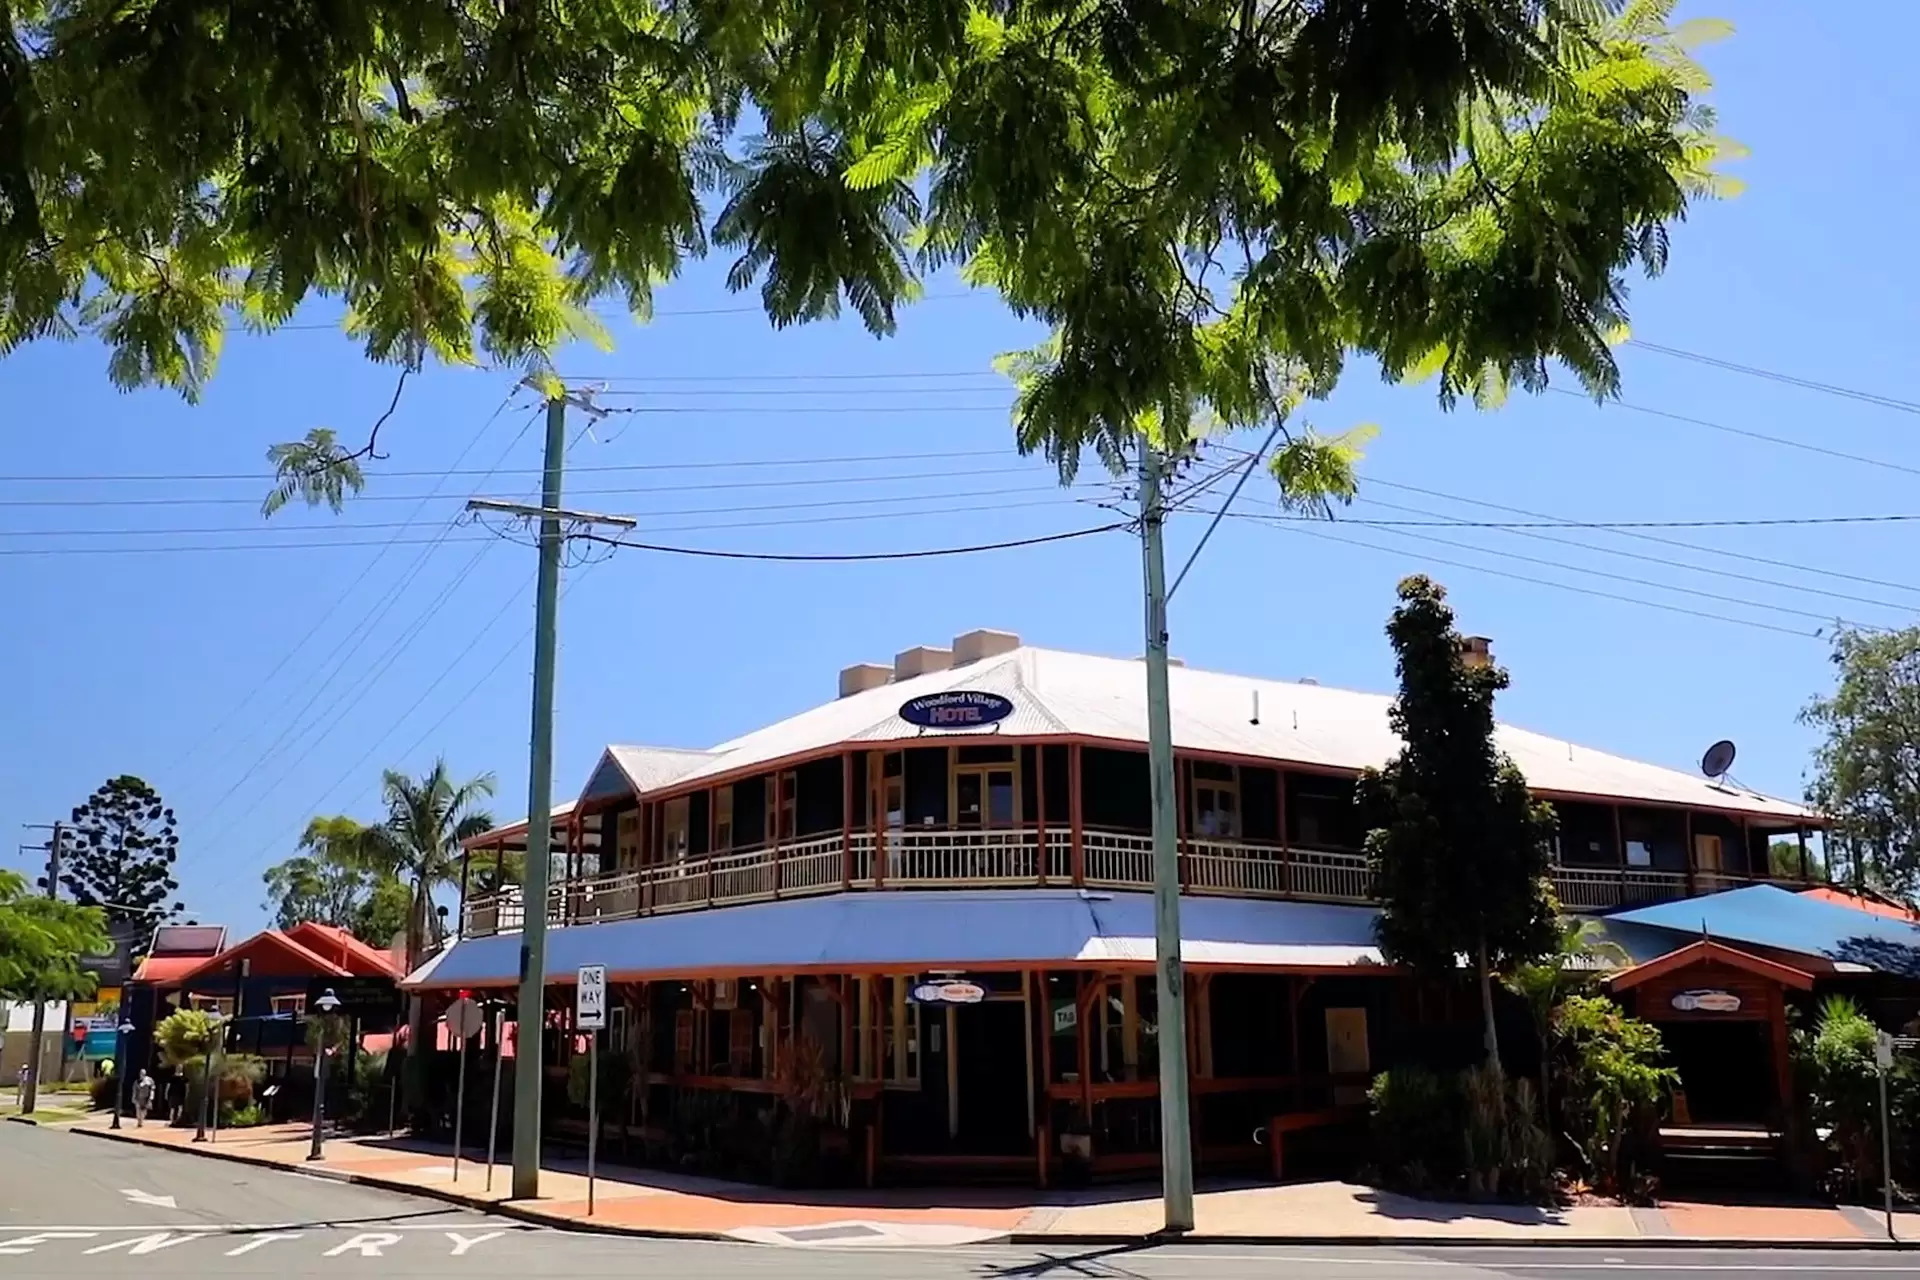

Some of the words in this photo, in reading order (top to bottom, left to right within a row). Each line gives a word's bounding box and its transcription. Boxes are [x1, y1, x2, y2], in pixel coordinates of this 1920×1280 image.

[912, 693, 966, 711] Woodford
[966, 693, 1002, 709] Village
[930, 707, 983, 723] HOTEL
[582, 971, 601, 985] ONE
[582, 990, 601, 1004] WAY
[1057, 1011, 1074, 1023] TAB
[0, 1230, 506, 1257] ENTRY
